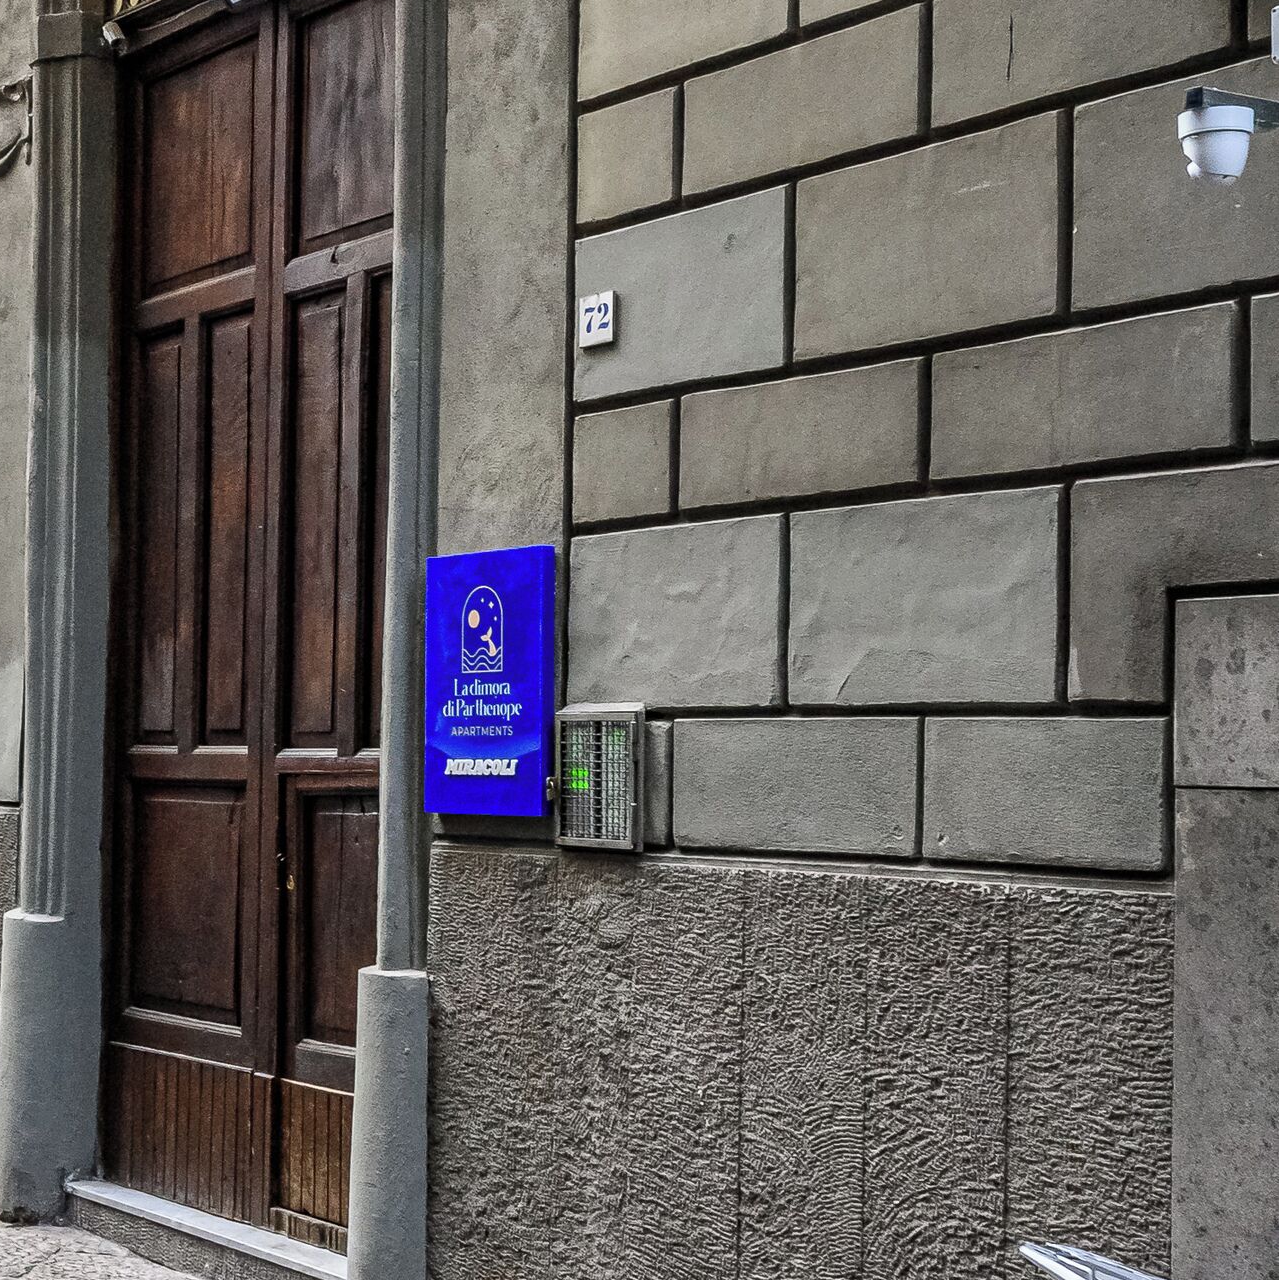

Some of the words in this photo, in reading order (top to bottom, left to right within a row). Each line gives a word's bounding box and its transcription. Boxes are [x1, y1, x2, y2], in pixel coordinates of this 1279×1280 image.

[584, 303, 610, 333] 72
[454, 678, 469, 697] La
[469, 678, 511, 697] dimora
[442, 700, 455, 717] di
[456, 699, 523, 721] Parthenope
[451, 725, 514, 737] APARTMENTS
[444, 758, 519, 776] MIRACOLI
